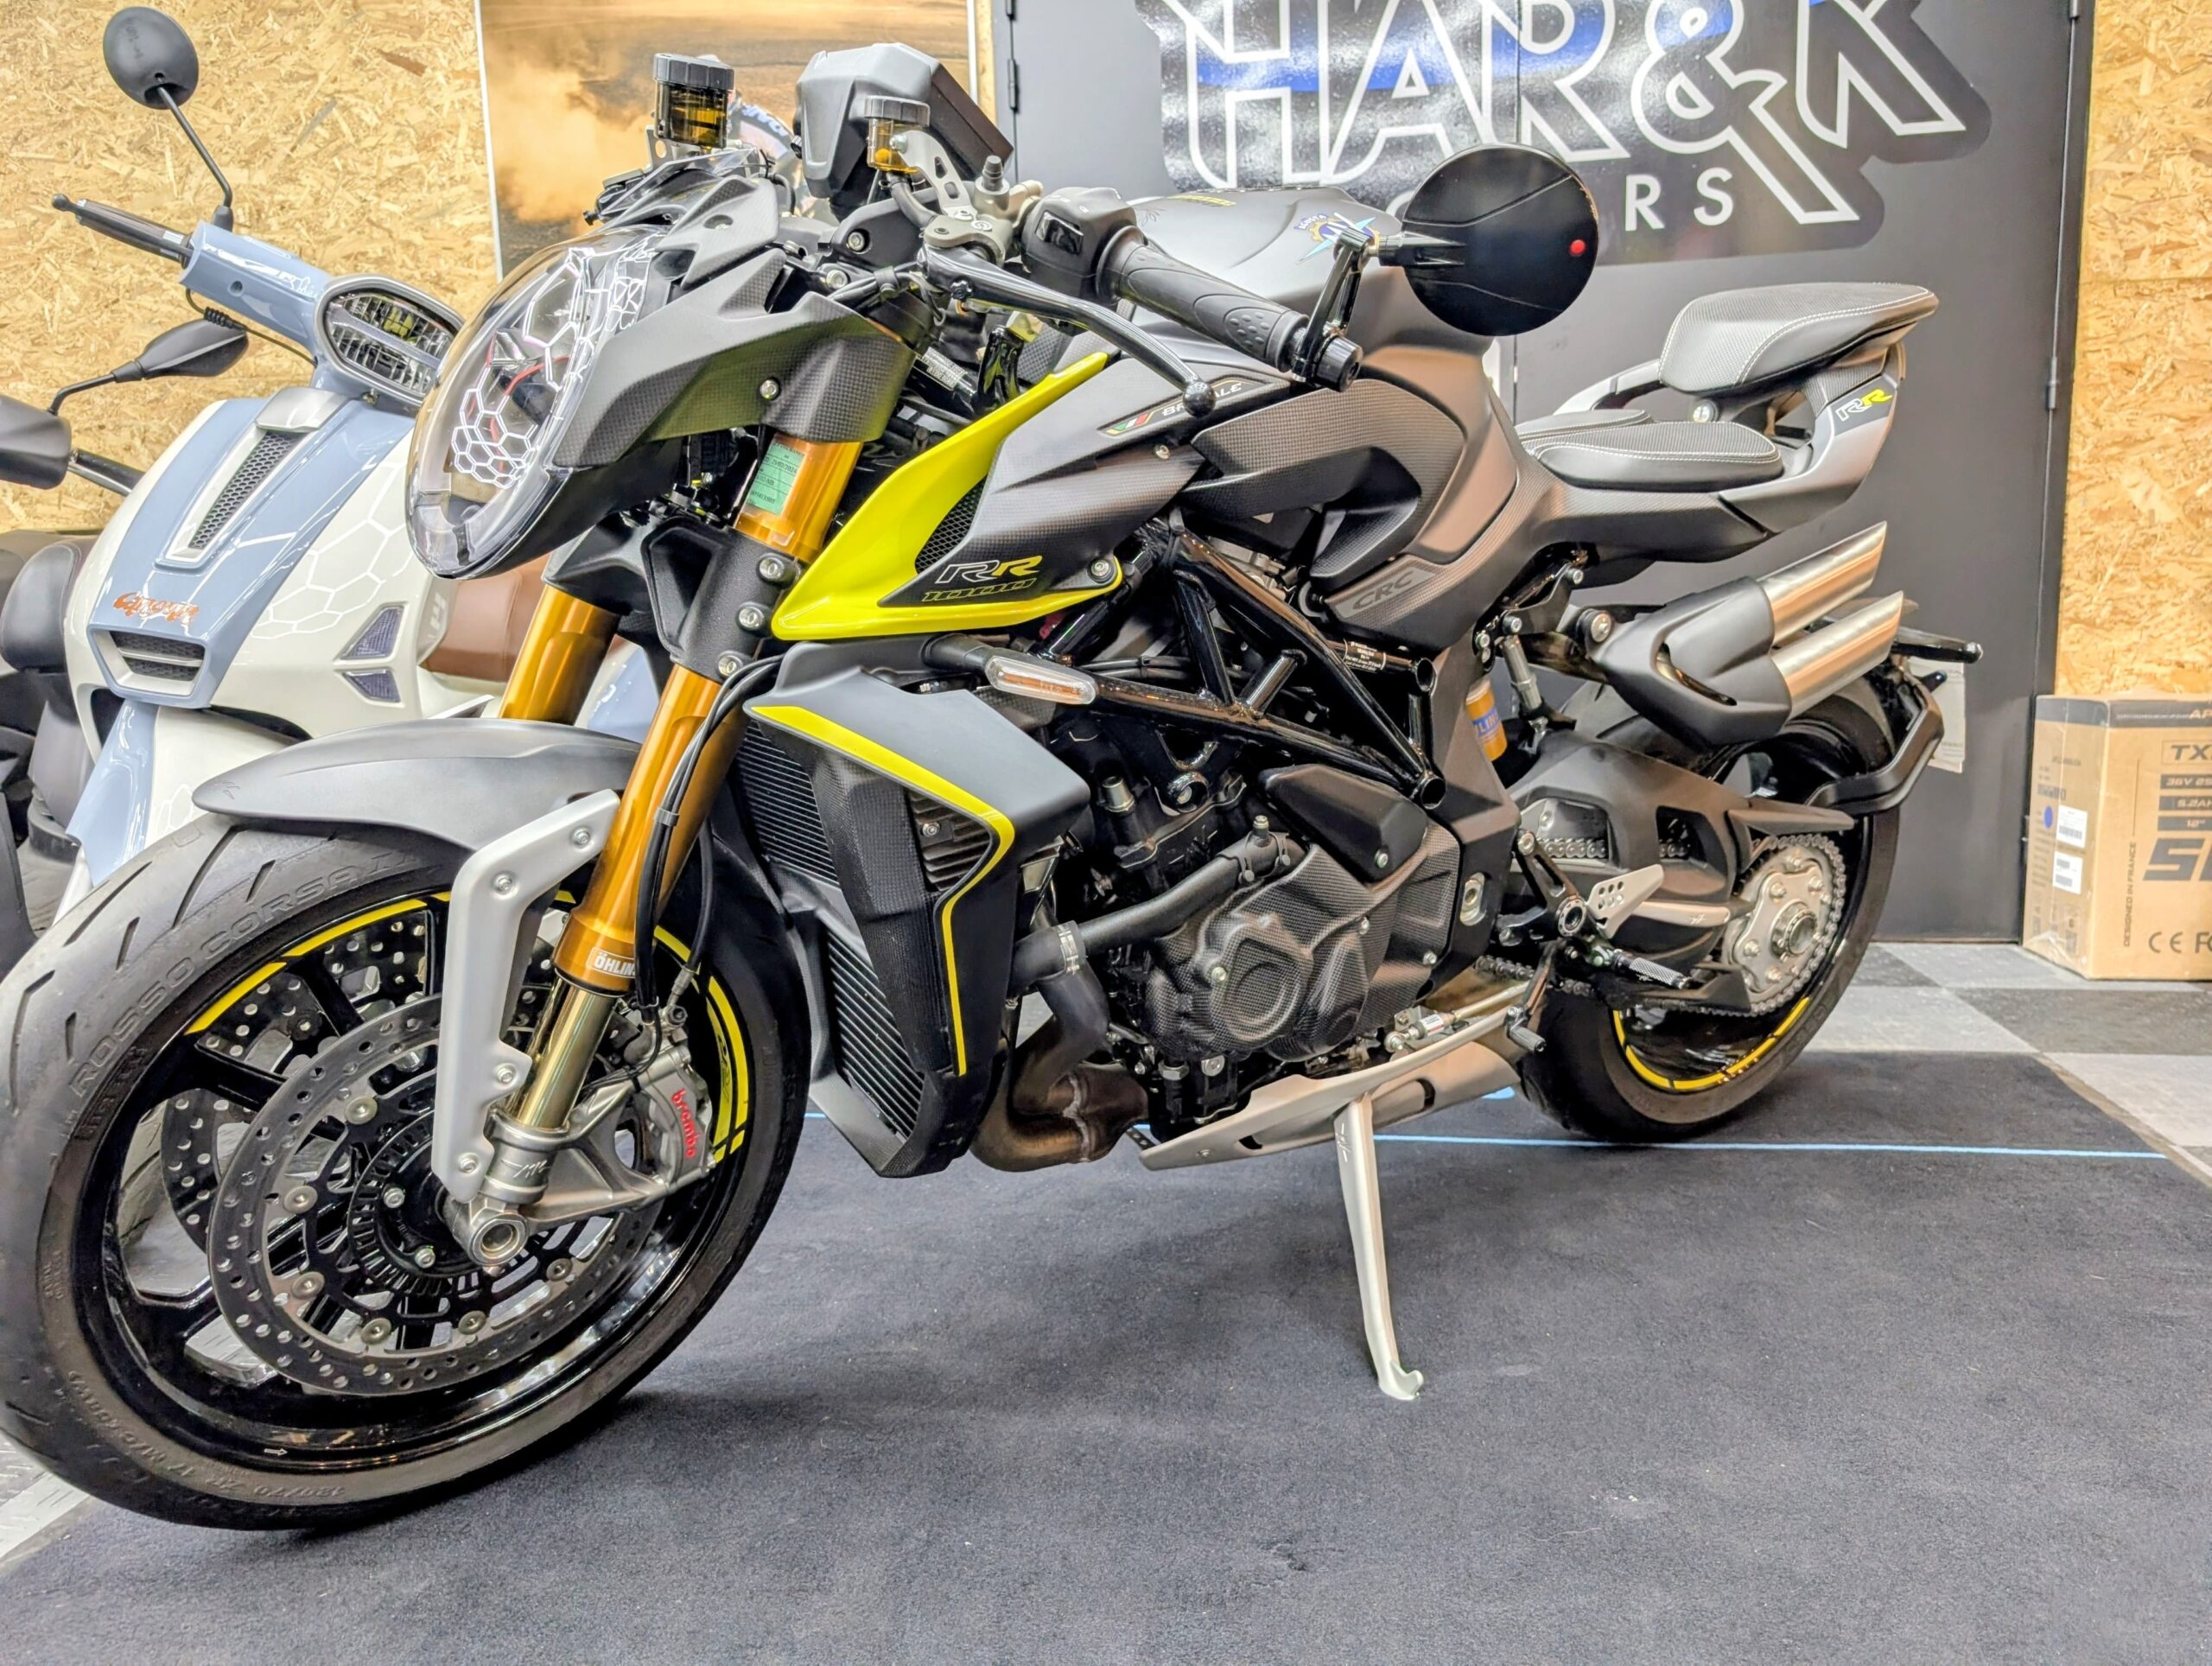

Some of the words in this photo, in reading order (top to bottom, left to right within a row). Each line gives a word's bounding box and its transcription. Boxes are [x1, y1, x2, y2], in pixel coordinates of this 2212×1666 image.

[1162, 383, 1243, 416] BRLE
[1835, 389, 1893, 422] RR
[935, 555, 1043, 584] RR
[921, 577, 1037, 602] 1000
[1352, 570, 1414, 610] CRC
[2171, 744, 2212, 761] TX
[2127, 842, 2137, 883] FRANCE
[2123, 895, 2133, 948] DESIGNED
[594, 951, 636, 977] ÖHLIN
[671, 1087, 700, 1160] brembo
